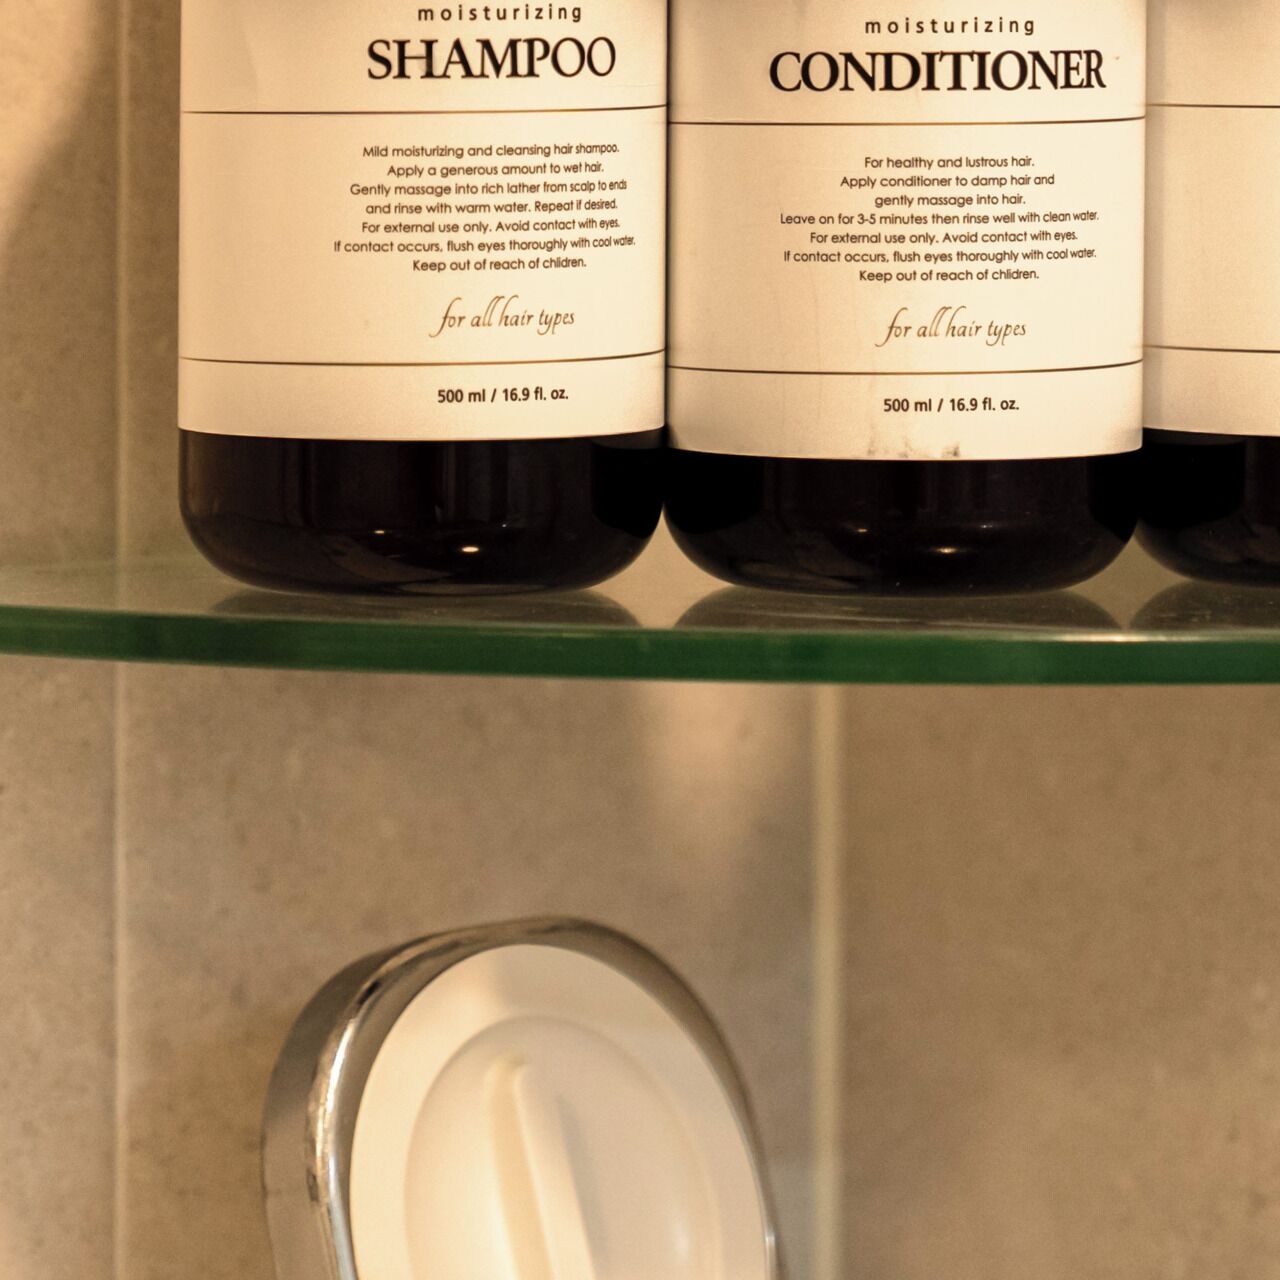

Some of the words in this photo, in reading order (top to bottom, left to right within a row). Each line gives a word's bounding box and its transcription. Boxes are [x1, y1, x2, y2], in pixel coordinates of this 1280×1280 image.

[417, 3, 582, 24] moisturizing
[865, 16, 1035, 37] moisturizing
[368, 37, 616, 79] SHAMPOO
[770, 50, 1106, 91] CONDITIONER
[362, 145, 389, 158] Mild
[391, 145, 465, 160] moisturizing
[466, 144, 493, 157] and
[495, 143, 552, 158] cleansing
[553, 143, 574, 155] hair
[575, 143, 620, 156] shampoo.
[387, 164, 425, 179] Apply
[439, 165, 499, 179] generous
[501, 162, 547, 176] amount
[562, 161, 583, 174] wet
[584, 160, 605, 173] hair.
[864, 156, 884, 169] For
[886, 156, 935, 171] healthy
[936, 156, 963, 169] and
[965, 156, 1009, 169] lustrous
[1011, 155, 1035, 168] hair.
[349, 183, 392, 198] Gently
[393, 185, 453, 198] massage
[454, 182, 479, 195] into
[481, 182, 505, 195] rich
[506, 181, 541, 195] lather
[542, 181, 568, 193] from
[569, 180, 597, 194] scalp
[608, 179, 628, 191] ends
[839, 175, 877, 190] Apply
[879, 175, 953, 188] conditioner
[970, 175, 1008, 189] damp
[1009, 173, 1032, 186] hair
[1033, 173, 1055, 186] and
[365, 202, 392, 215] and
[393, 202, 423, 215] rinse
[425, 201, 453, 214] with
[454, 203, 491, 214] warm
[493, 201, 532, 213] water.
[534, 199, 575, 214] Repeat
[583, 197, 618, 211] desired.
[874, 194, 915, 209] gently
[917, 195, 974, 209] massage
[976, 193, 1000, 206] into
[1001, 193, 1027, 205] hair.
[361, 221, 381, 234] For
[383, 221, 435, 234] external
[437, 223, 460, 234] use
[462, 220, 493, 235] only.
[495, 219, 531, 233] Avoid
[532, 218, 577, 232] contact
[577, 217, 598, 229] with
[780, 213, 816, 225] Leave
[837, 212, 855, 225] for
[856, 212, 877, 225] 3-5
[879, 213, 929, 225] minutes
[931, 213, 961, 225] then
[962, 212, 990, 225] rinse
[992, 211, 1016, 224] well
[1017, 211, 1041, 223] with
[1042, 211, 1071, 223] clean
[343, 240, 395, 253] contact
[446, 239, 475, 253] flush
[477, 241, 506, 253] eyes
[508, 237, 569, 253] thoroughly
[569, 237, 591, 249] with
[591, 235, 613, 249] cool
[809, 231, 829, 244] For
[830, 232, 882, 244] external
[883, 233, 907, 245] use
[908, 231, 939, 246] only.
[941, 231, 979, 244] Avoid
[980, 231, 1028, 243] contact
[1029, 229, 1052, 241] with
[412, 259, 447, 273] Keep
[449, 258, 471, 272] out
[489, 257, 526, 271] reach
[541, 256, 587, 270] children.
[792, 250, 842, 263] contact
[892, 250, 921, 263] flush
[923, 252, 953, 265] eyes
[955, 249, 1020, 265] thoroughly
[1021, 249, 1045, 261] with
[1045, 247, 1069, 261] cool
[859, 269, 893, 284] Keep
[895, 269, 918, 282] out
[935, 269, 974, 282] reach
[991, 268, 1040, 281] children.
[429, 297, 466, 338] for
[470, 296, 505, 327] all
[498, 295, 534, 327] hair
[537, 310, 574, 335] types
[875, 307, 912, 347] for
[917, 307, 952, 338] all
[946, 306, 982, 337] hair
[986, 320, 1026, 346] types
[437, 388, 465, 404] 500
[467, 388, 486, 403] ml
[502, 387, 531, 402] 16.9
[550, 388, 569, 401] oz.
[883, 397, 910, 413] 500
[913, 397, 933, 413] ml
[949, 397, 979, 412] 16.9
[999, 399, 1020, 411] oz.
